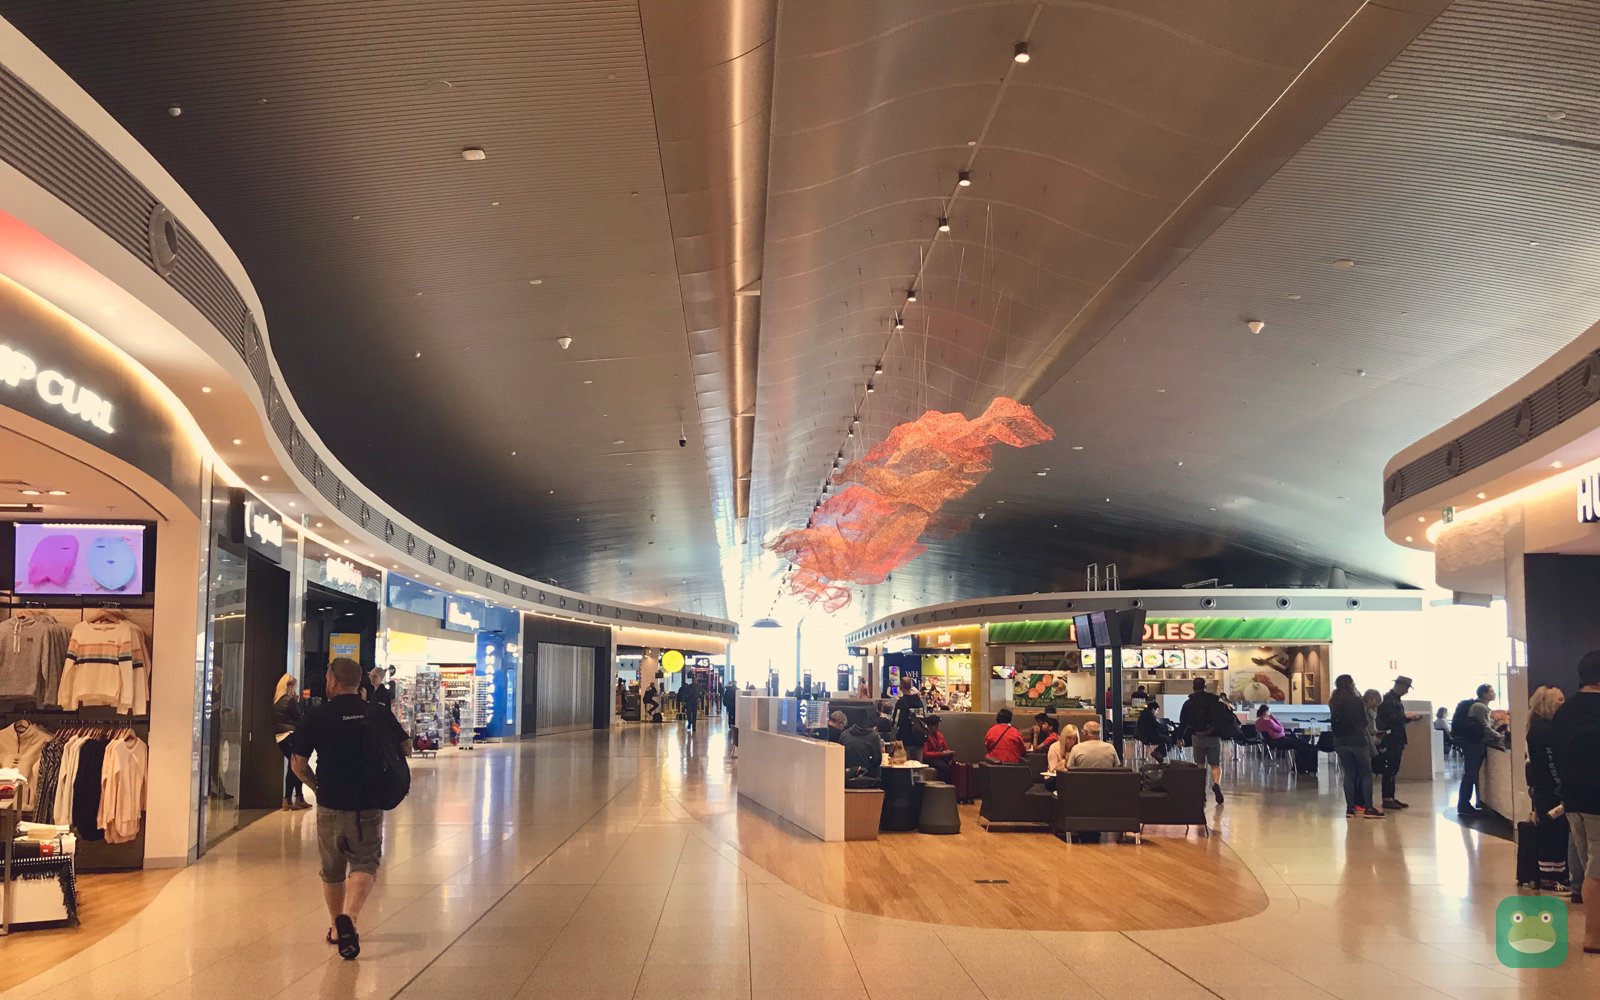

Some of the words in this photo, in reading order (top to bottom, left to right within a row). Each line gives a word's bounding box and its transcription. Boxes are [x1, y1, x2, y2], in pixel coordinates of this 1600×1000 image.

[0, 345, 36, 386] IP
[37, 370, 114, 434] CURL
[697, 659, 709, 667] 45
